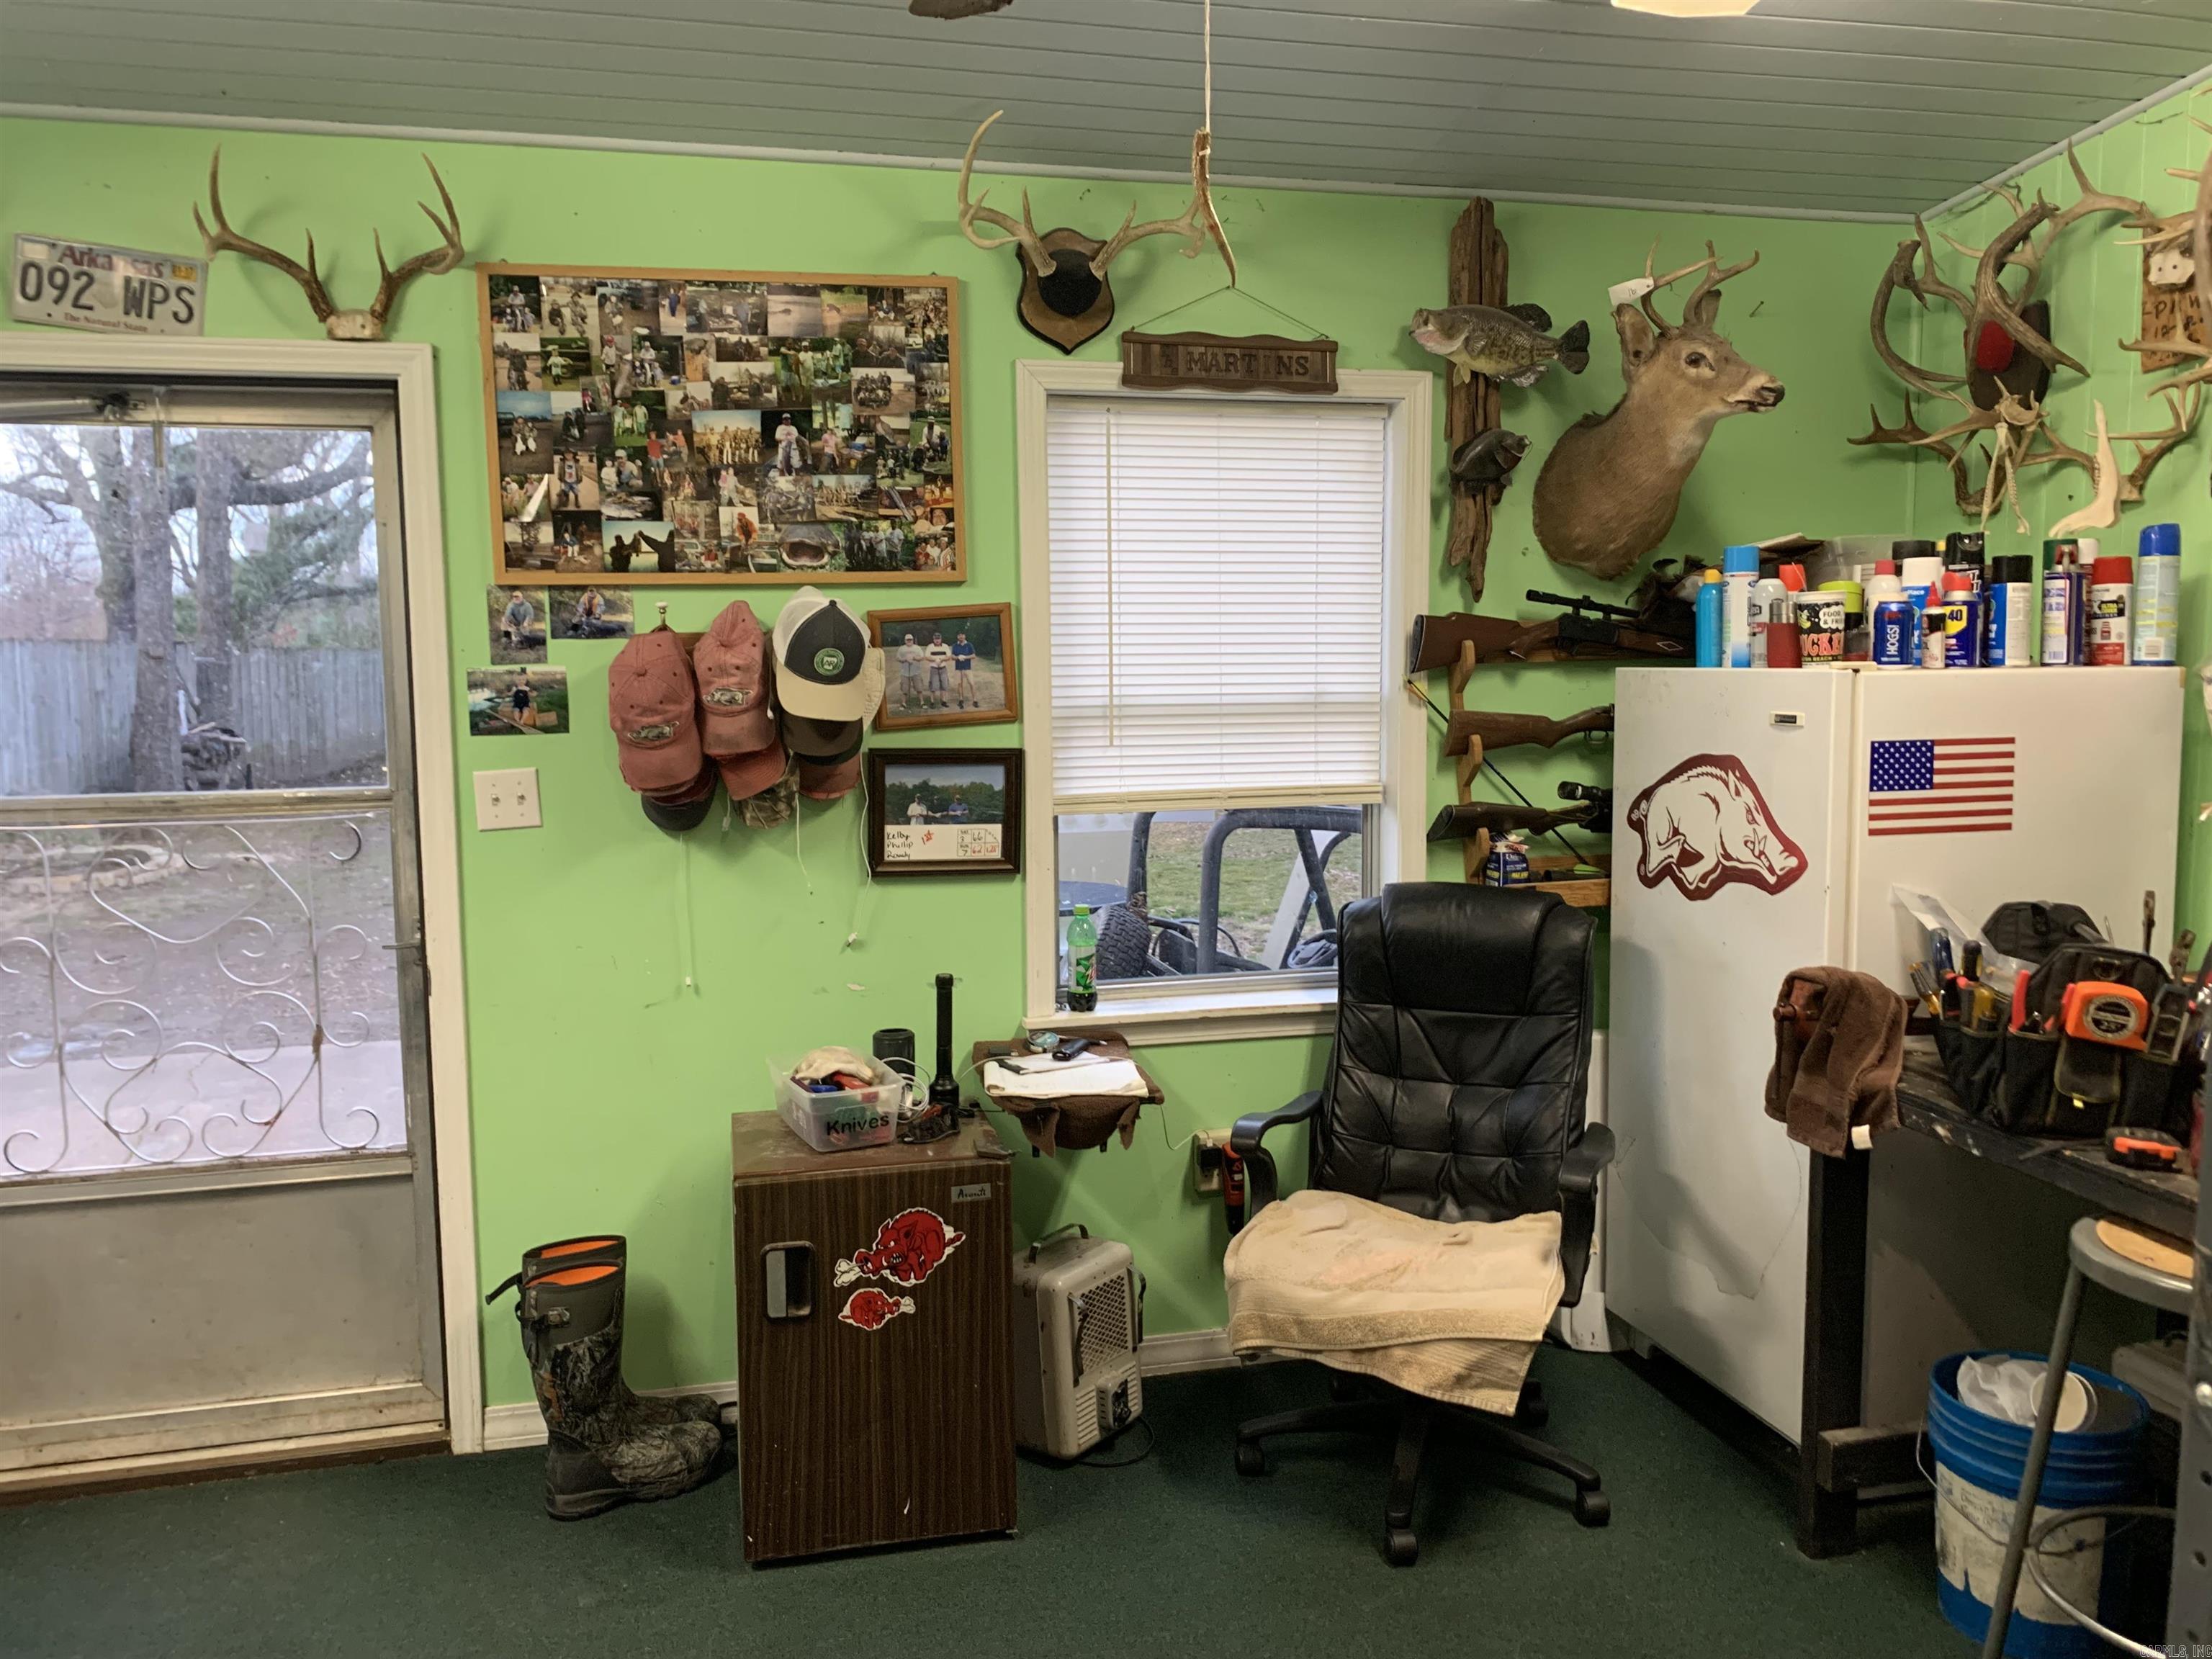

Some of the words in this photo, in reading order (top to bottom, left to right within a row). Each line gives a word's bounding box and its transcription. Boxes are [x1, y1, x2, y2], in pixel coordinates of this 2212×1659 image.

[19, 261, 95, 311] 092
[123, 275, 195, 324] WPS
[826, 1115, 890, 1136] Knives
